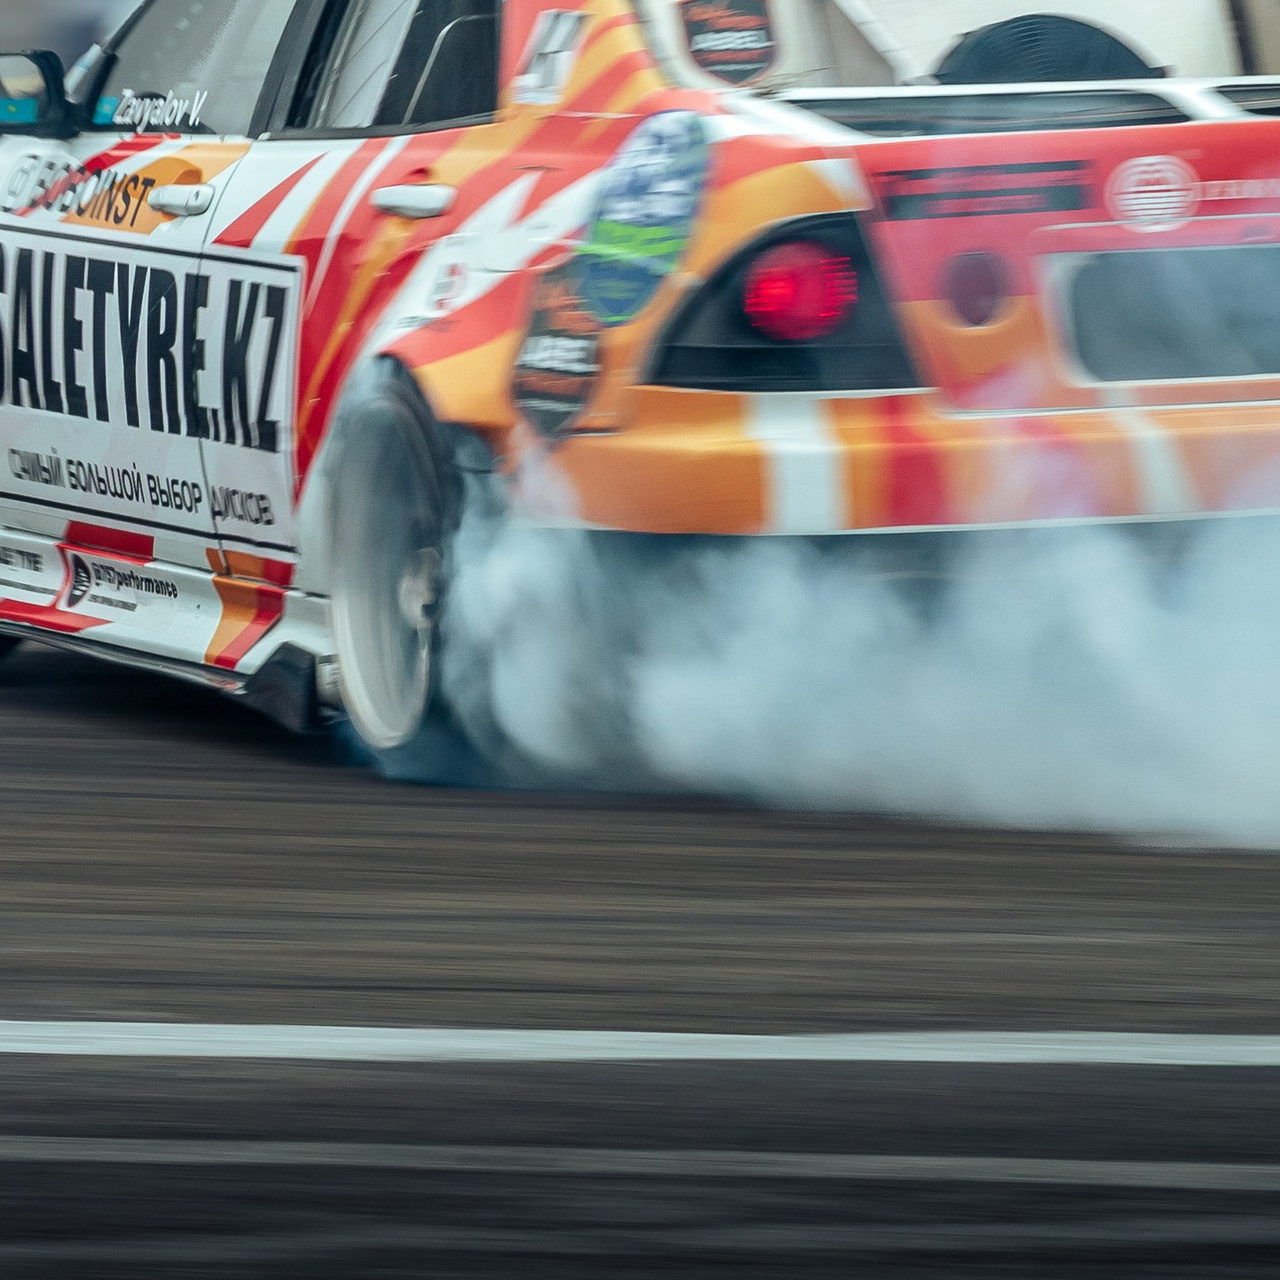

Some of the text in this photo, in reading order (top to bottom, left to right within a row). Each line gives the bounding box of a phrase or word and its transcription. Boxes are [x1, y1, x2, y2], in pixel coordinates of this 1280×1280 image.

[112, 88, 208, 134] Zavyalov V.
[0, 241, 288, 453] ALETYRE.KZ
[66, 458, 145, 504] БОЛЬШОЙ
[147, 474, 203, 514] ВЫБОР
